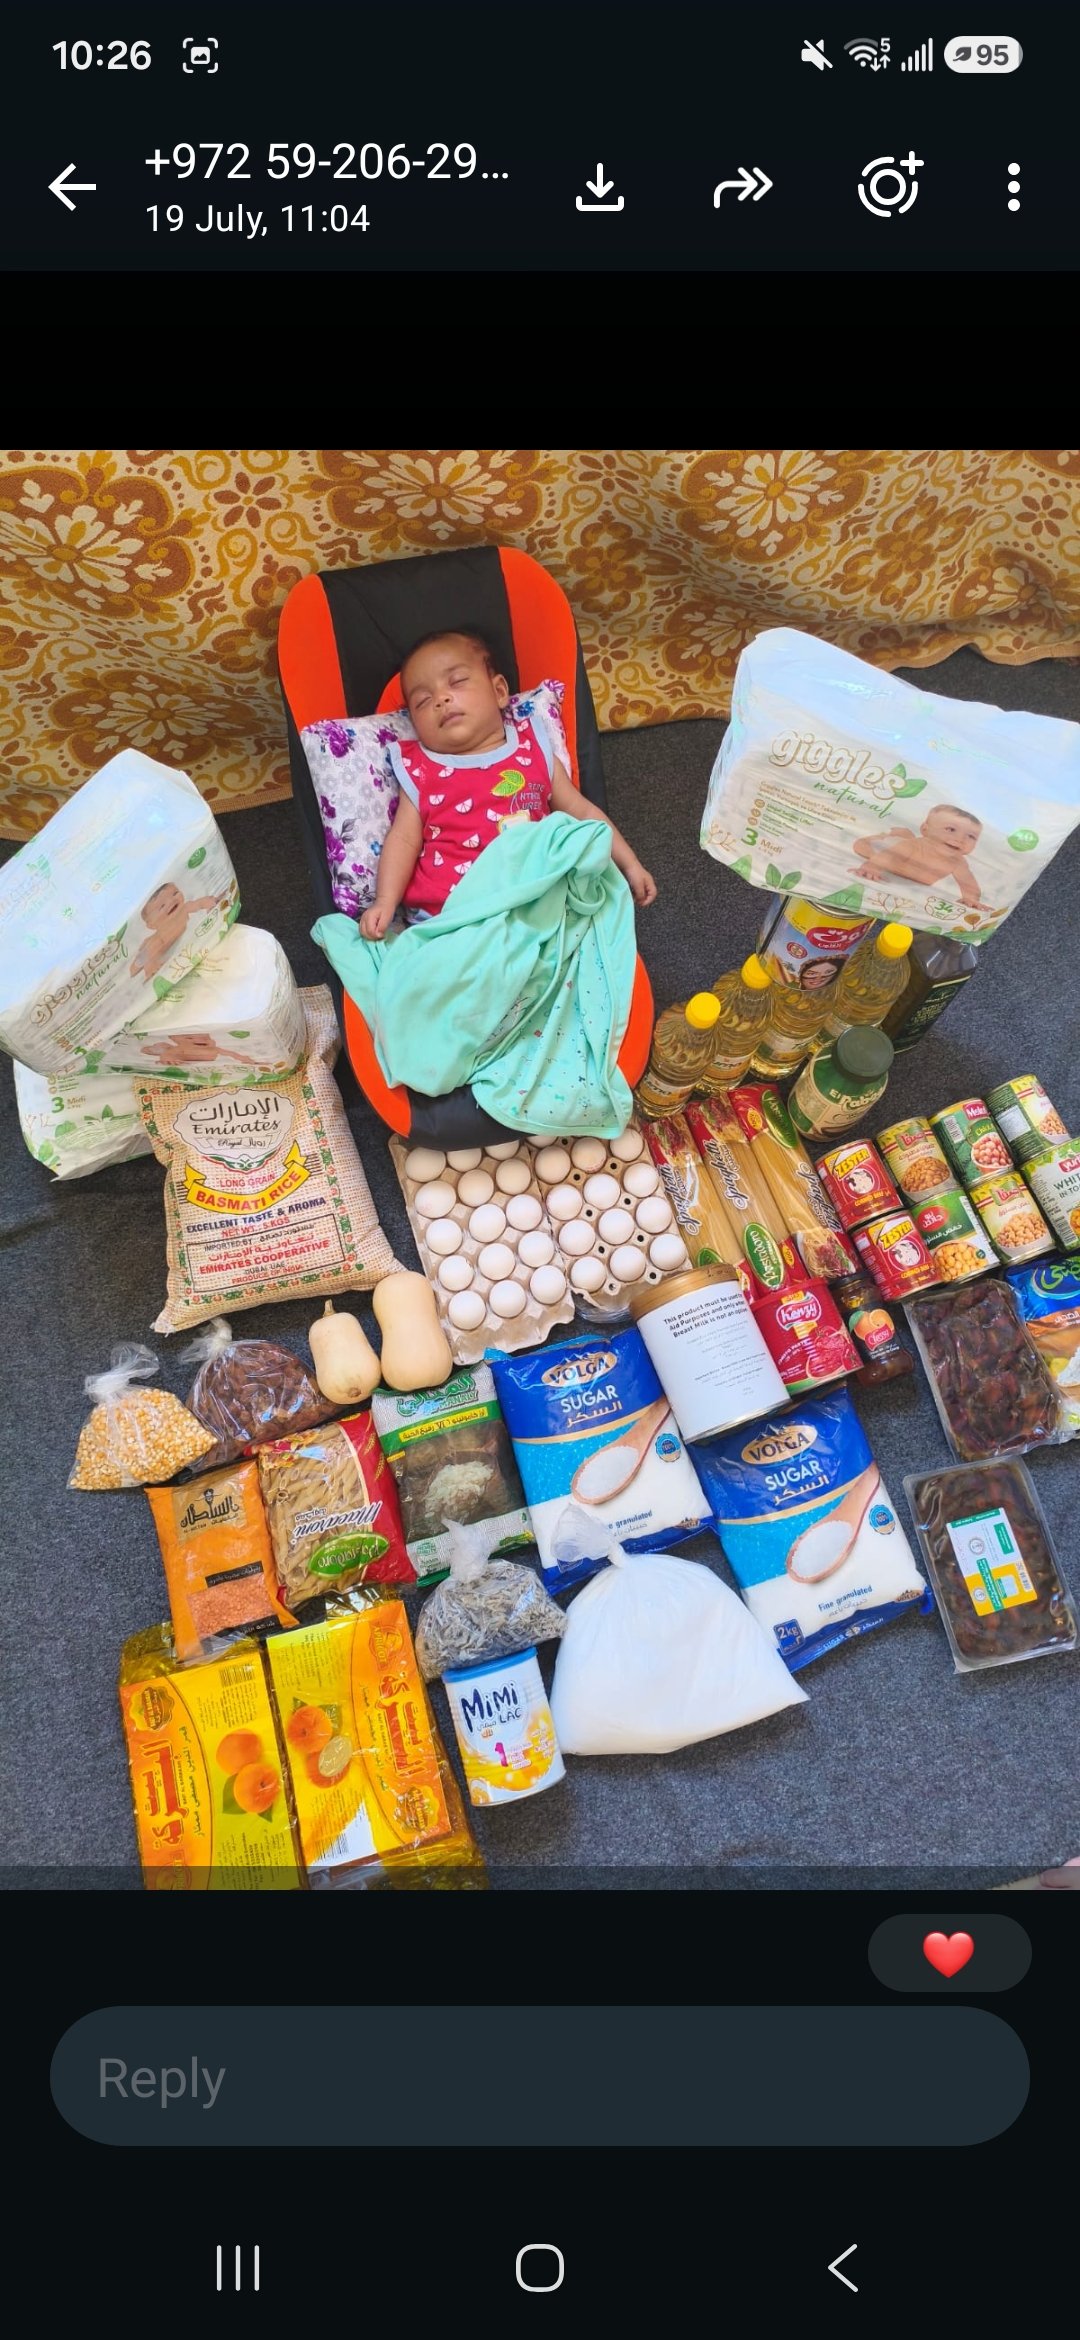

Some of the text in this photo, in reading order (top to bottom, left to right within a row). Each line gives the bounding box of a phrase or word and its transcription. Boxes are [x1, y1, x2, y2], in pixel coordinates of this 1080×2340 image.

[52, 40, 153, 71] 10:26
[976, 44, 1010, 67] 95
[145, 143, 252, 180] +972
[146, 203, 371, 240] 19 July, 11:04
[768, 729, 909, 801] giggles
[814, 782, 894, 819] natural
[741, 827, 759, 846] 3
[51, 1096, 65, 1113] 3
[189, 1096, 280, 1124] الإمارات
[192, 1119, 282, 1136] Emirates
[702, 1138, 749, 1211] Spaghetti
[835, 1149, 870, 1179] ZESTER
[195, 1171, 302, 1211] BASMATI RICE
[220, 1171, 276, 1188] LONG GRAIN
[795, 1160, 844, 1236] Spaghetti
[186, 1197, 327, 1234] EXCELLENT TASTE & AROMA
[880, 1220, 914, 1250] ZESTER
[199, 1239, 331, 1275] EMIRATES COOPERATIVE
[663, 1315, 677, 1325] This
[677, 1303, 704, 1322] product
[704, 1297, 720, 1309] must
[673, 1325, 694, 1338] Breast
[694, 1319, 709, 1329] Milk
[716, 1312, 727, 1321] not
[680, 1310, 711, 1328] Purposes
[711, 1304, 723, 1314] and
[549, 1357, 611, 1384] VOLGA
[560, 1384, 619, 1413] SUGAR
[567, 1400, 623, 1428] السكر
[748, 1432, 811, 1461] VOLGA
[765, 1460, 824, 1491] SUGAR
[774, 1474, 830, 1506] السكر
[290, 1501, 384, 1546] Macaroni
[614, 1509, 653, 1529] granulated
[818, 1584, 873, 1613] Fine granulated
[777, 1625, 799, 1640] 2kg
[500, 1707, 522, 1724] LAC
[494, 1741, 509, 1768] 1
[100, 2056, 227, 2109] Reply
